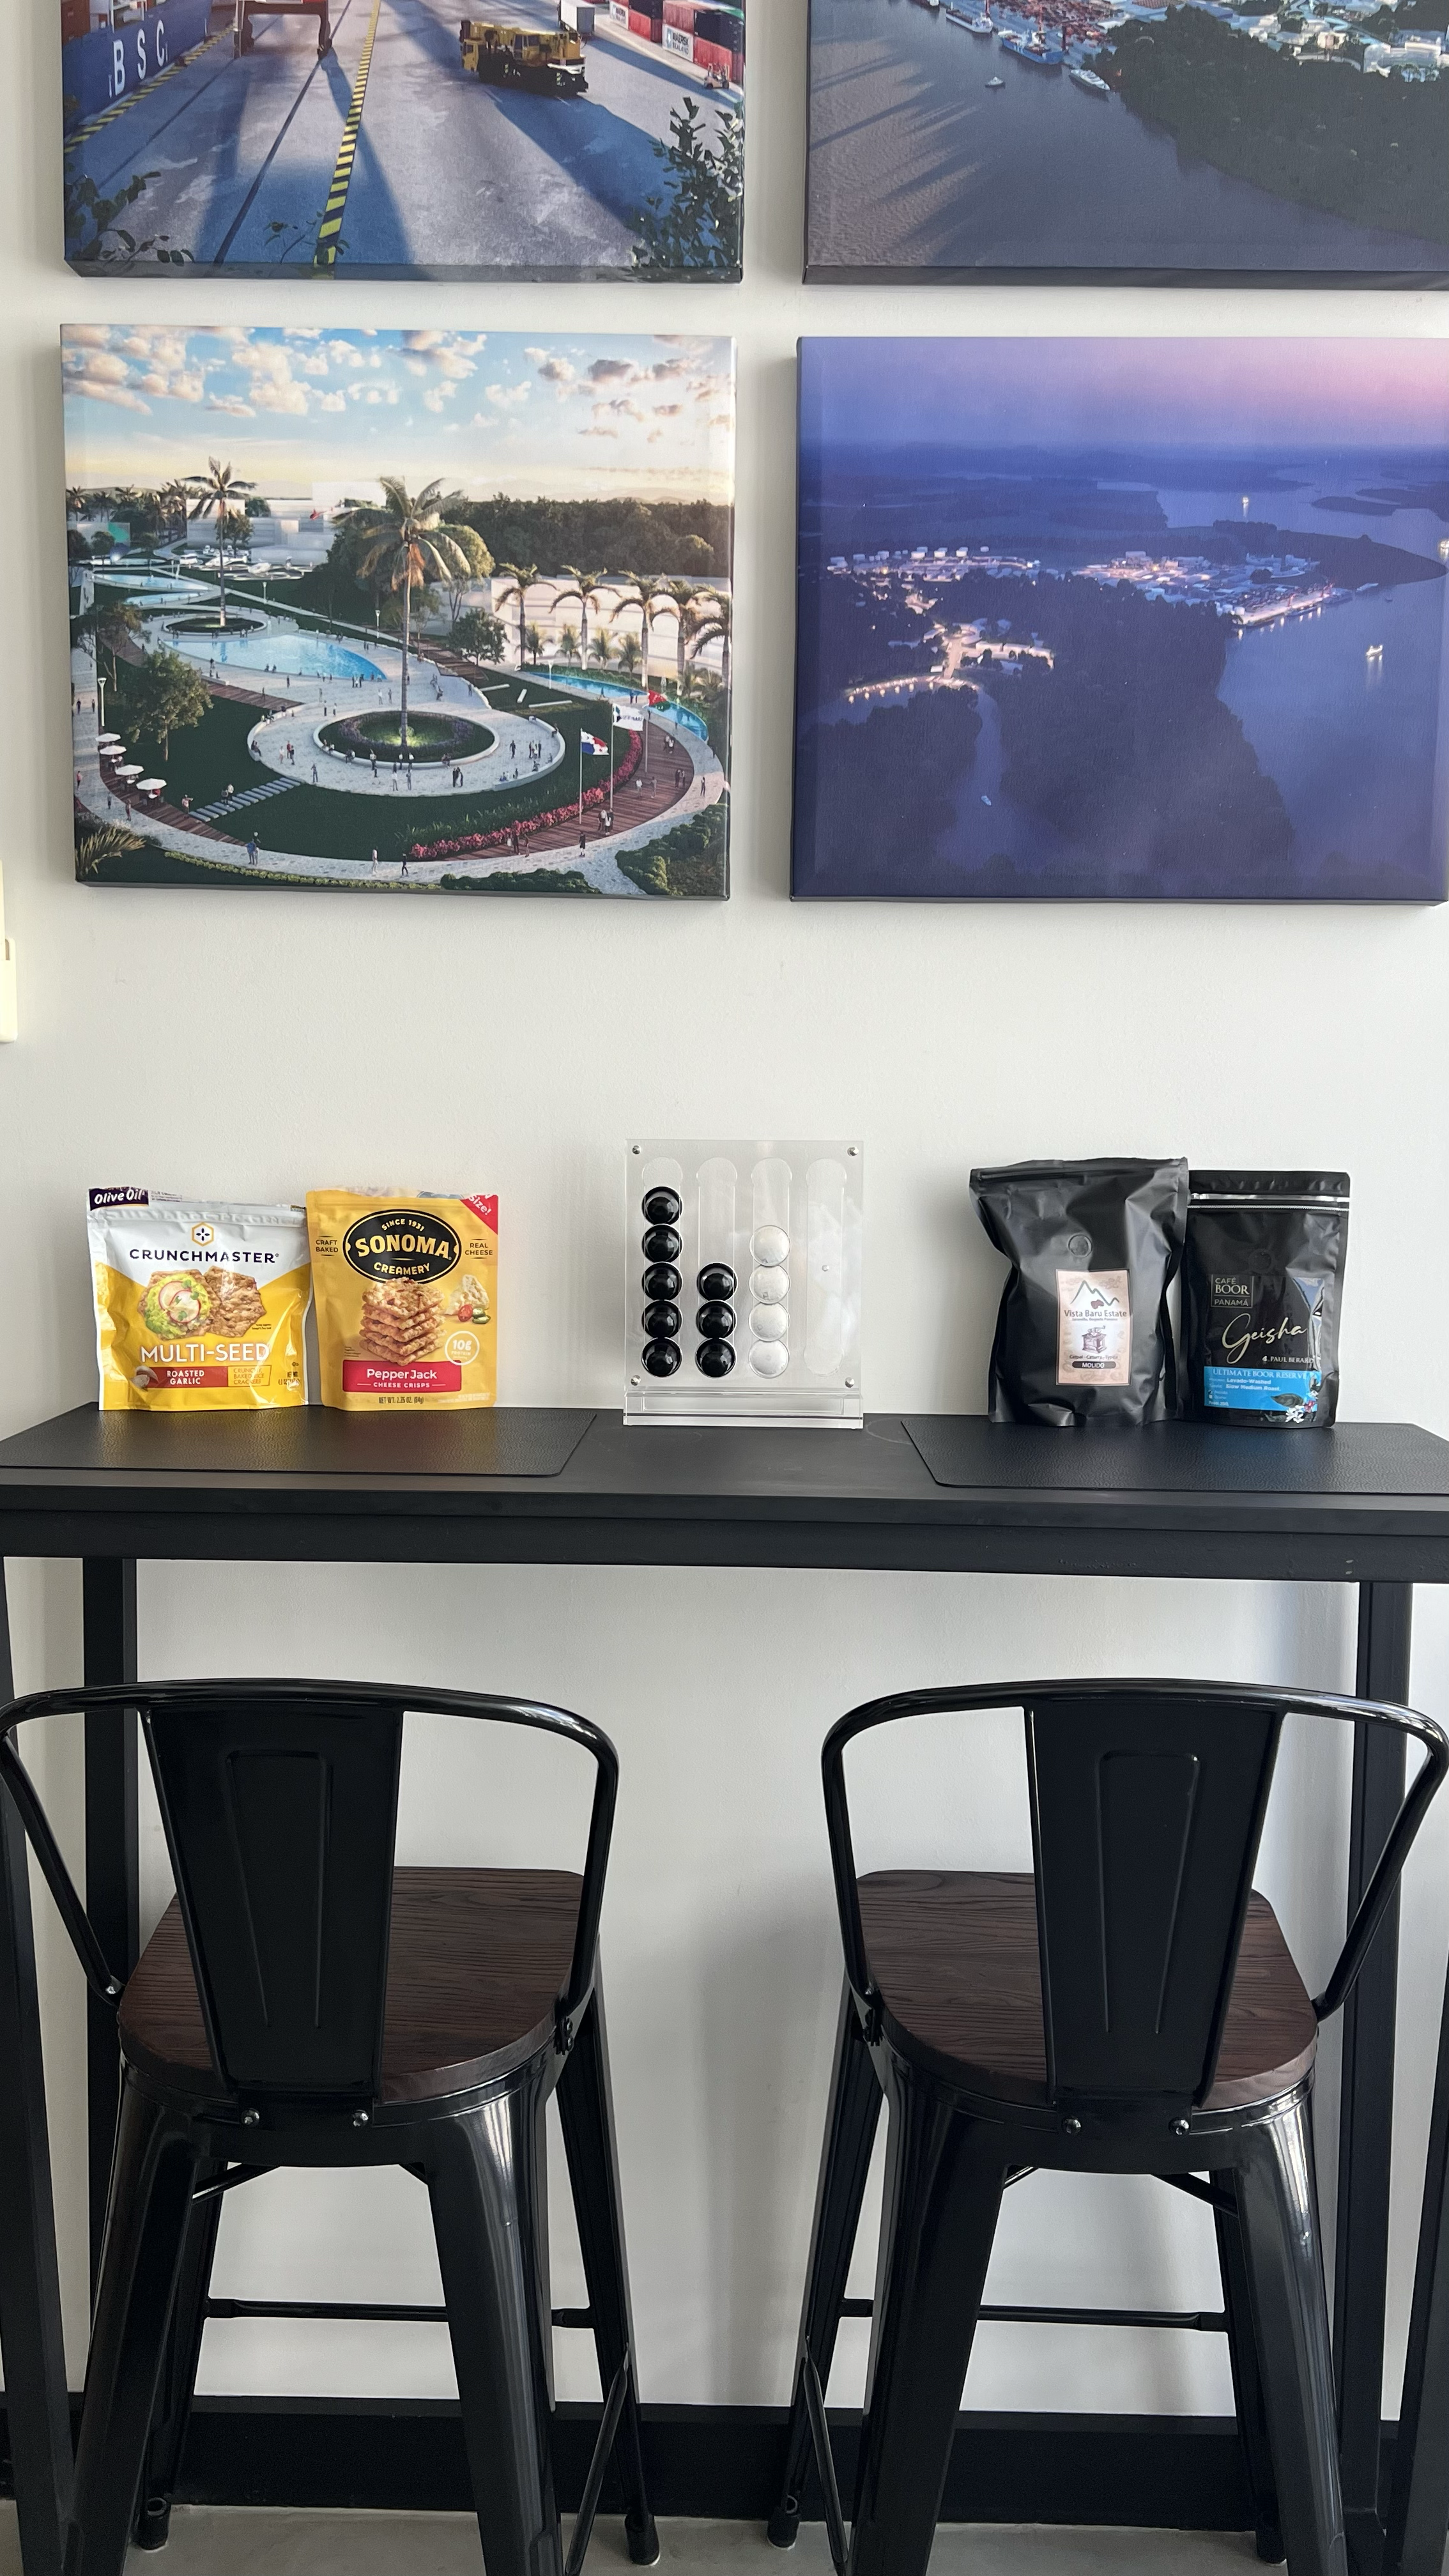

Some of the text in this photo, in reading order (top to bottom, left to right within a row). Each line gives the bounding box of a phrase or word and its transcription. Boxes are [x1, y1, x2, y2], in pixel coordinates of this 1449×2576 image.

[94, 1192, 125, 1204] Olive
[126, 1188, 142, 1200] Oil
[381, 1219, 425, 1232] SINCE 1931
[355, 1234, 450, 1260] SONOMA
[373, 1262, 431, 1275] CREAMERY
[1215, 1276, 1236, 1285] CAFÉ
[1215, 1284, 1250, 1295] BOOR
[1214, 1298, 1249, 1307] PANAMÁ
[452, 1339, 472, 1351] 10g
[1222, 1313, 1308, 1364] Geisha
[141, 1343, 270, 1363] MULTI-SEED
[367, 1368, 438, 1381] Pepper Jack
[1213, 1368, 1251, 1377] ULTIMATE
